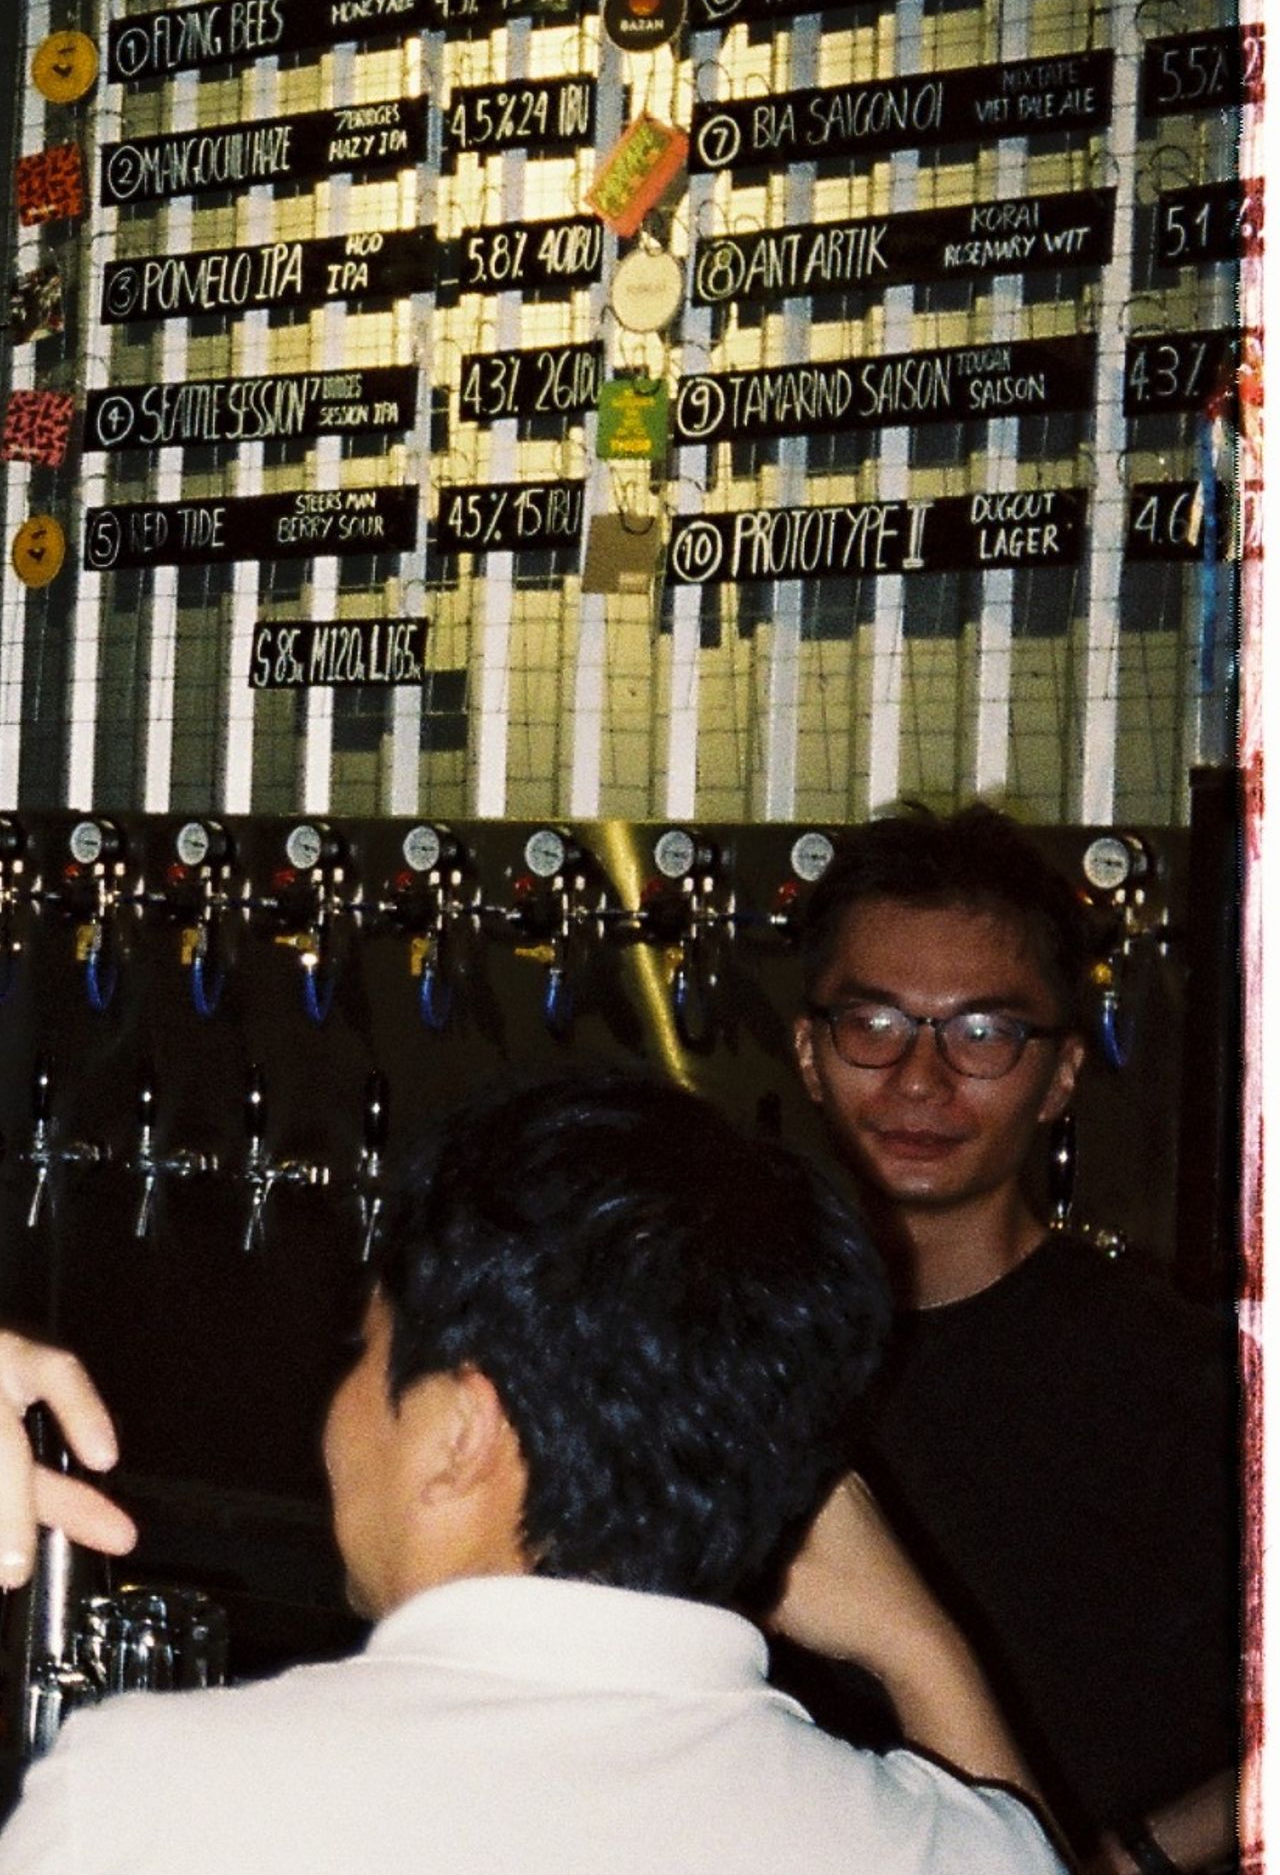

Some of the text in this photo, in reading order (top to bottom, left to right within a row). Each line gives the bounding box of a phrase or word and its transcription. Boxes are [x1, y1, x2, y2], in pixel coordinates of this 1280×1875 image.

[153, 6, 223, 69] FLYING
[753, 104, 796, 149] BIA
[1058, 87, 1094, 117] ALE
[328, 134, 376, 163] HAZY
[379, 128, 408, 156] IPA
[970, 201, 1040, 233] KORAI
[1043, 227, 1090, 254] WIT
[142, 254, 251, 311] POMELO
[255, 242, 304, 301] IPA
[327, 262, 369, 293] IPA
[730, 368, 851, 430] TAMARIND
[860, 354, 953, 417] SAISON
[970, 373, 1046, 411] SAISON
[176, 507, 227, 549] TIDE
[276, 515, 332, 543] BERRY
[338, 514, 385, 540] SOUR
[971, 492, 1059, 524] DUGOUT
[732, 504, 902, 578] PROTOTYPE
[979, 524, 1060, 561] LAGER
